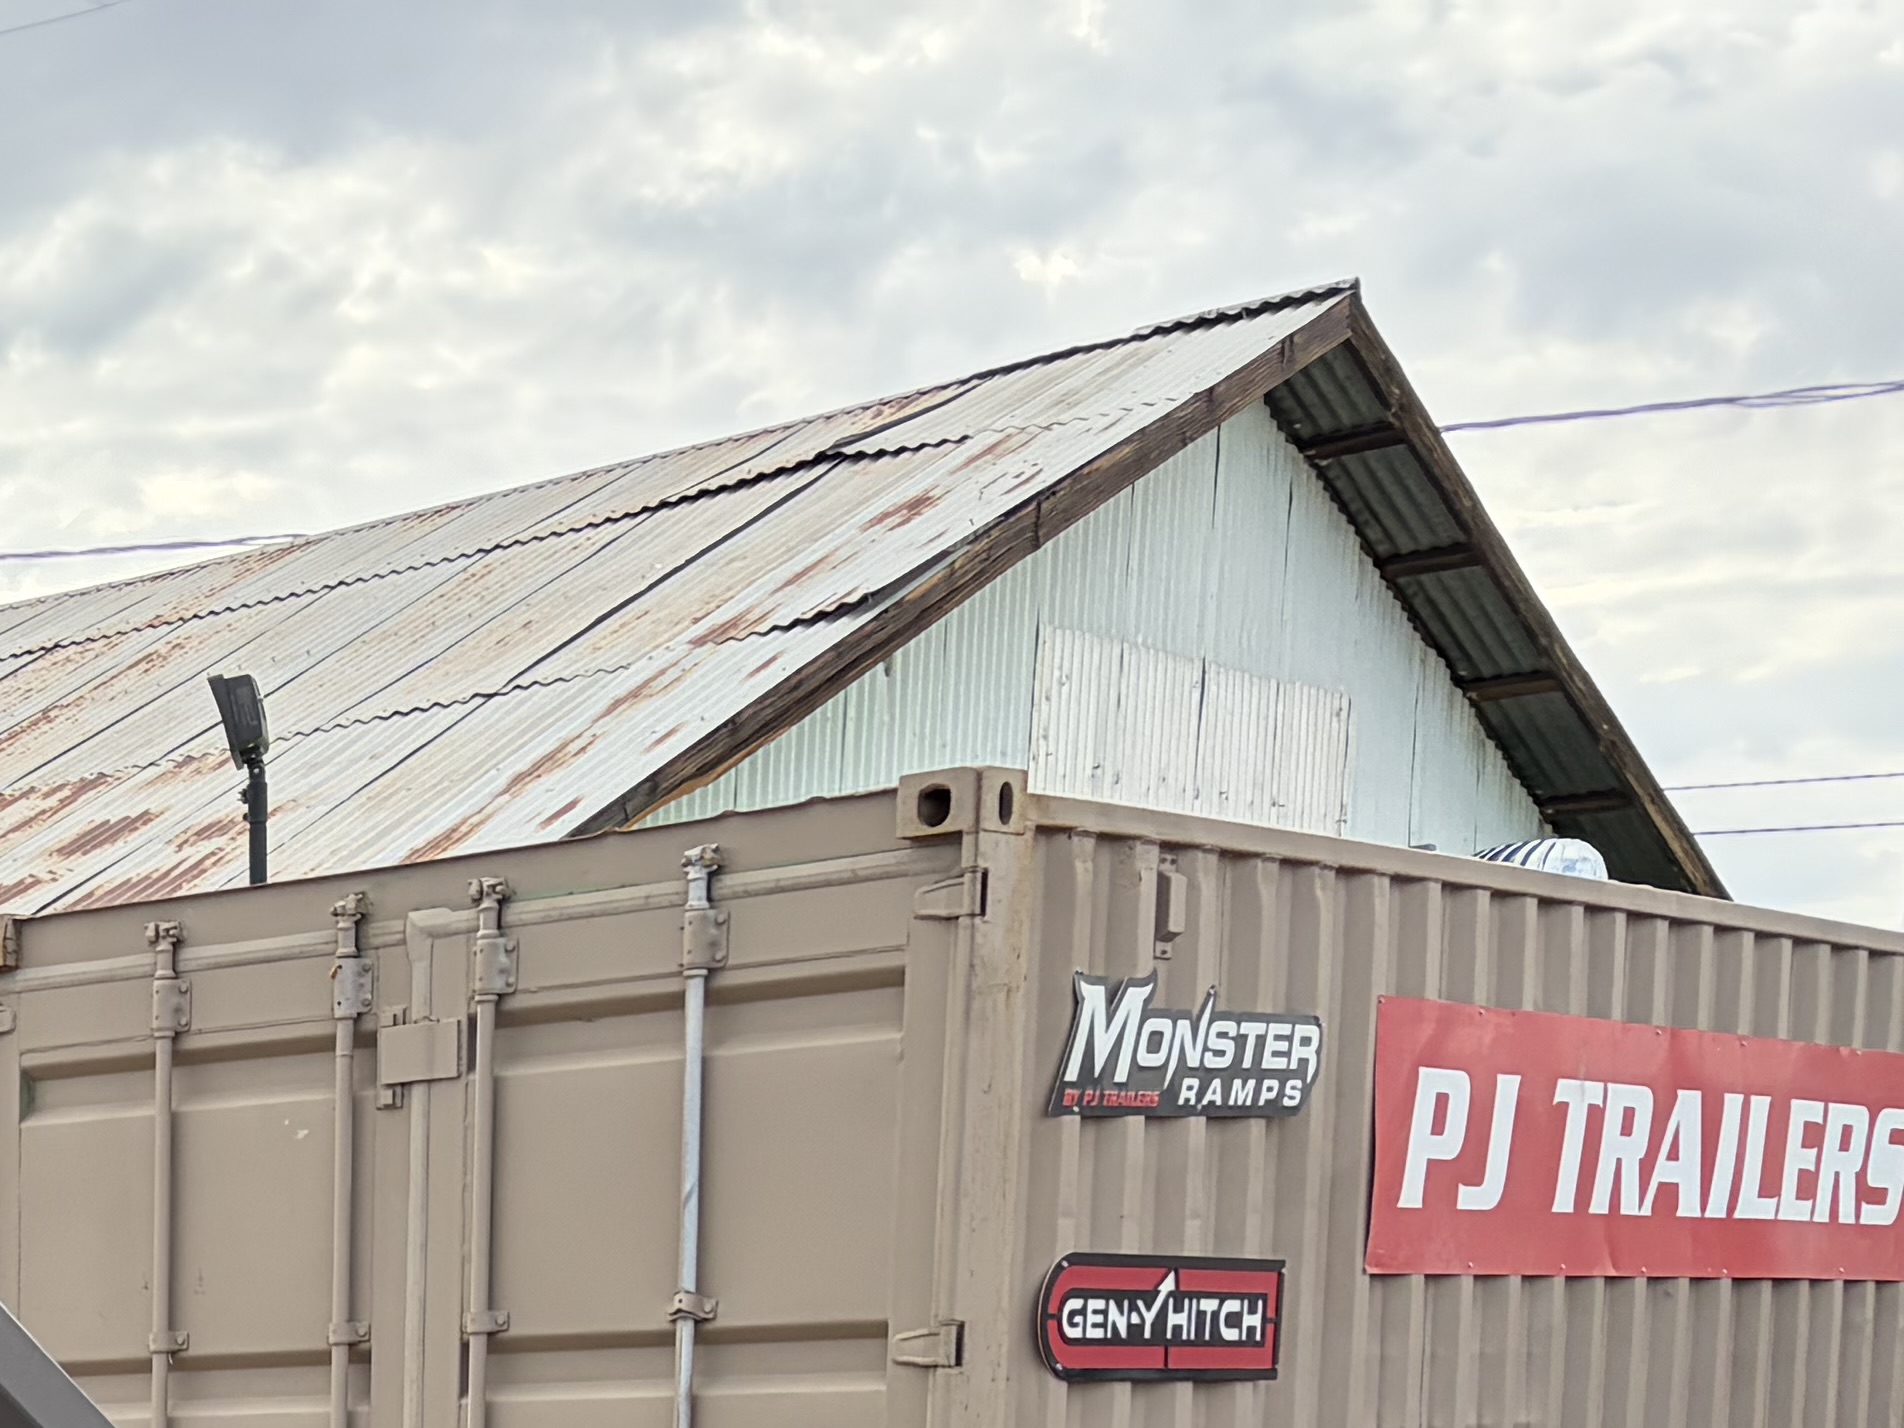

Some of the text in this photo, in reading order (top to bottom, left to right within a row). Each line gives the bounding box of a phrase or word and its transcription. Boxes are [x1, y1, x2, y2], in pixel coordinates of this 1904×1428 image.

[1063, 980, 1321, 1090] MONSTER
[1062, 1089, 1160, 1108] BY PJ TRAILERS
[1177, 1077, 1303, 1107] RAMPS
[1396, 1066, 1904, 1226] PJ TRAILERS
[1166, 1297, 1263, 1341] HITCH
